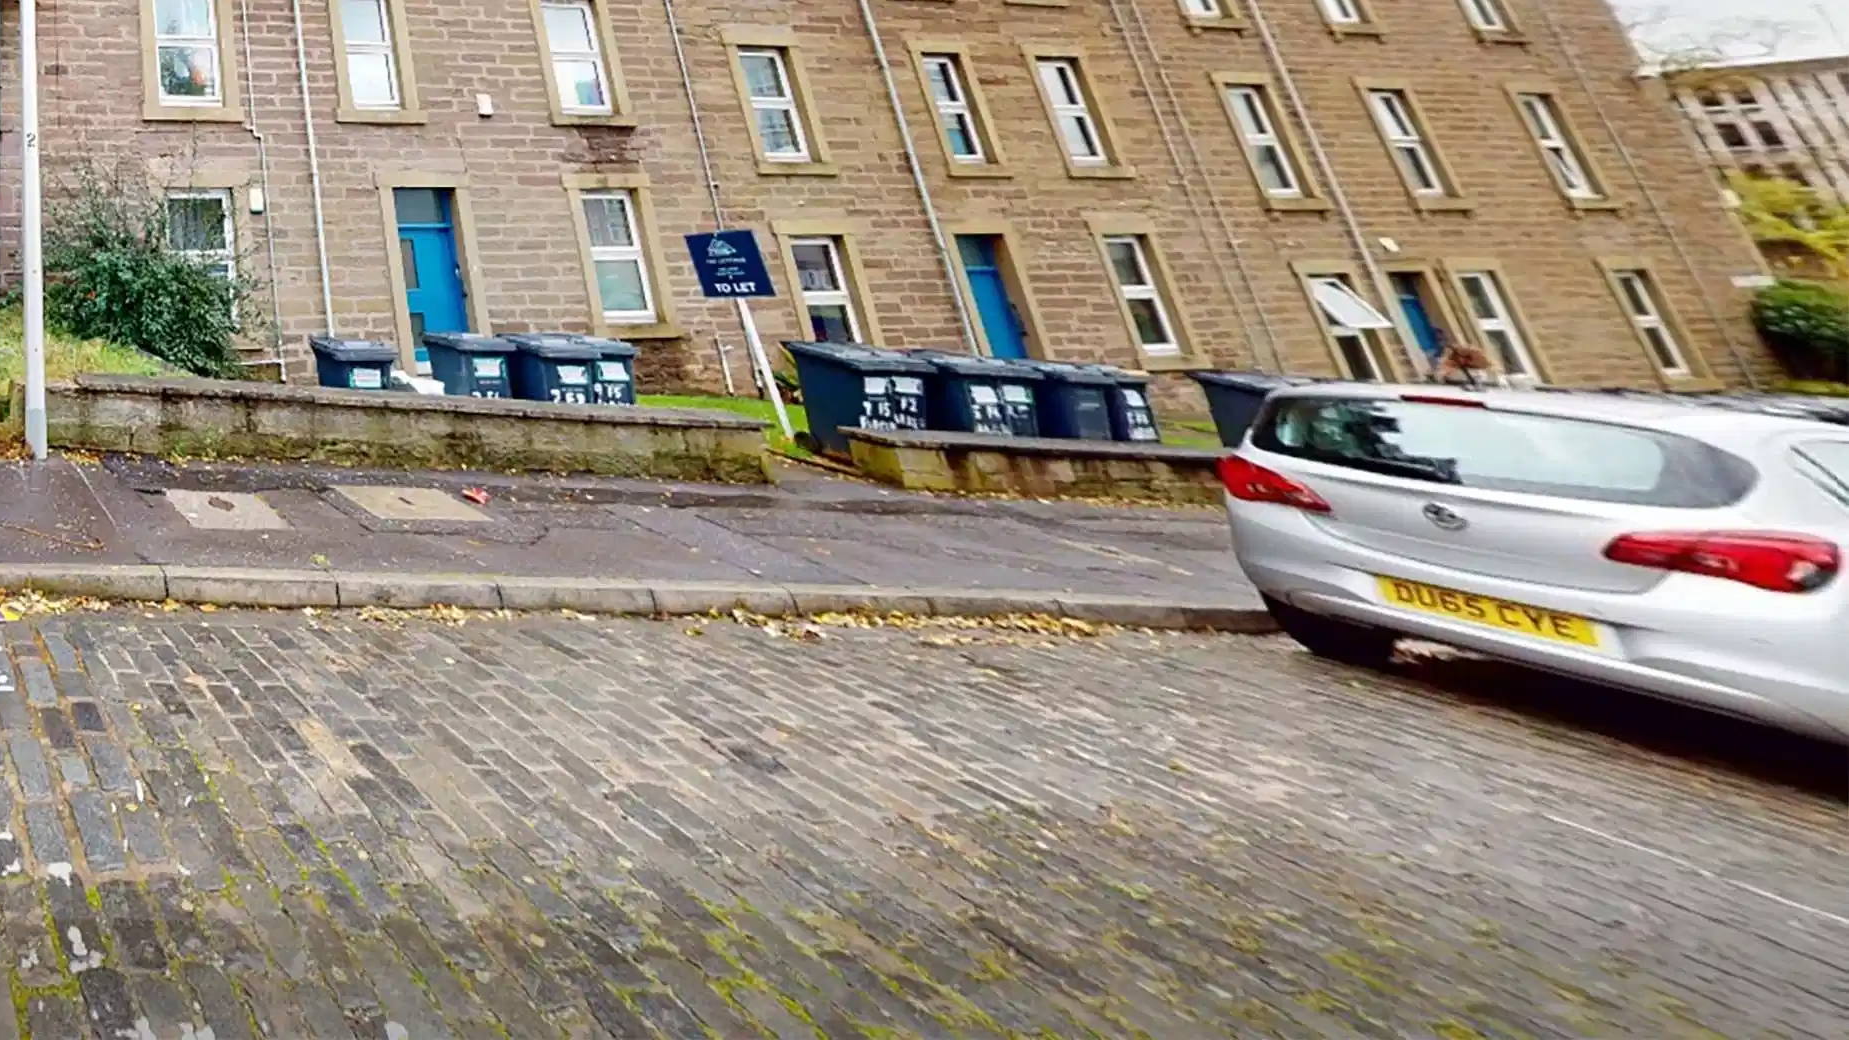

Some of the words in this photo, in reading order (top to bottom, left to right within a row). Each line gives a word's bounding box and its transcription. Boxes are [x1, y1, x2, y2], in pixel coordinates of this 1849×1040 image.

[714, 282, 731, 293] TO
[732, 281, 756, 293] LET
[1393, 580, 1486, 618] DU65
[1495, 602, 1579, 639] CYE
